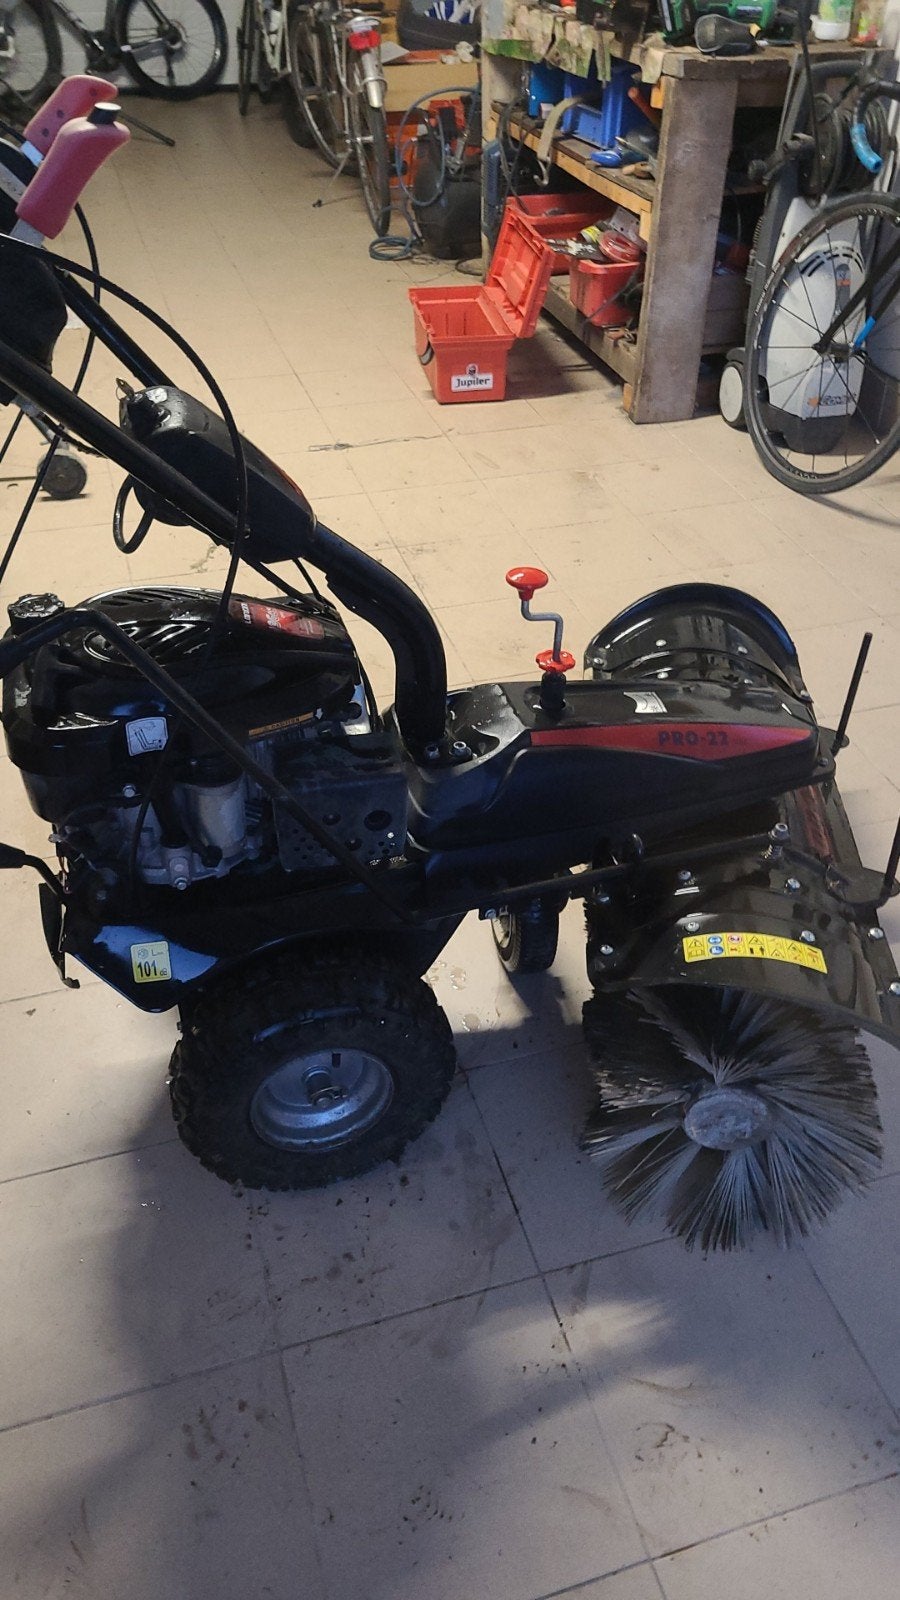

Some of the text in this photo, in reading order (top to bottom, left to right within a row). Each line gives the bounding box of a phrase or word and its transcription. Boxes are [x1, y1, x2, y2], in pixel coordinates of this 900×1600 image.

[455, 377, 491, 388] Jupiler
[659, 731, 728, 746] PRO-22
[137, 960, 158, 978] 101
